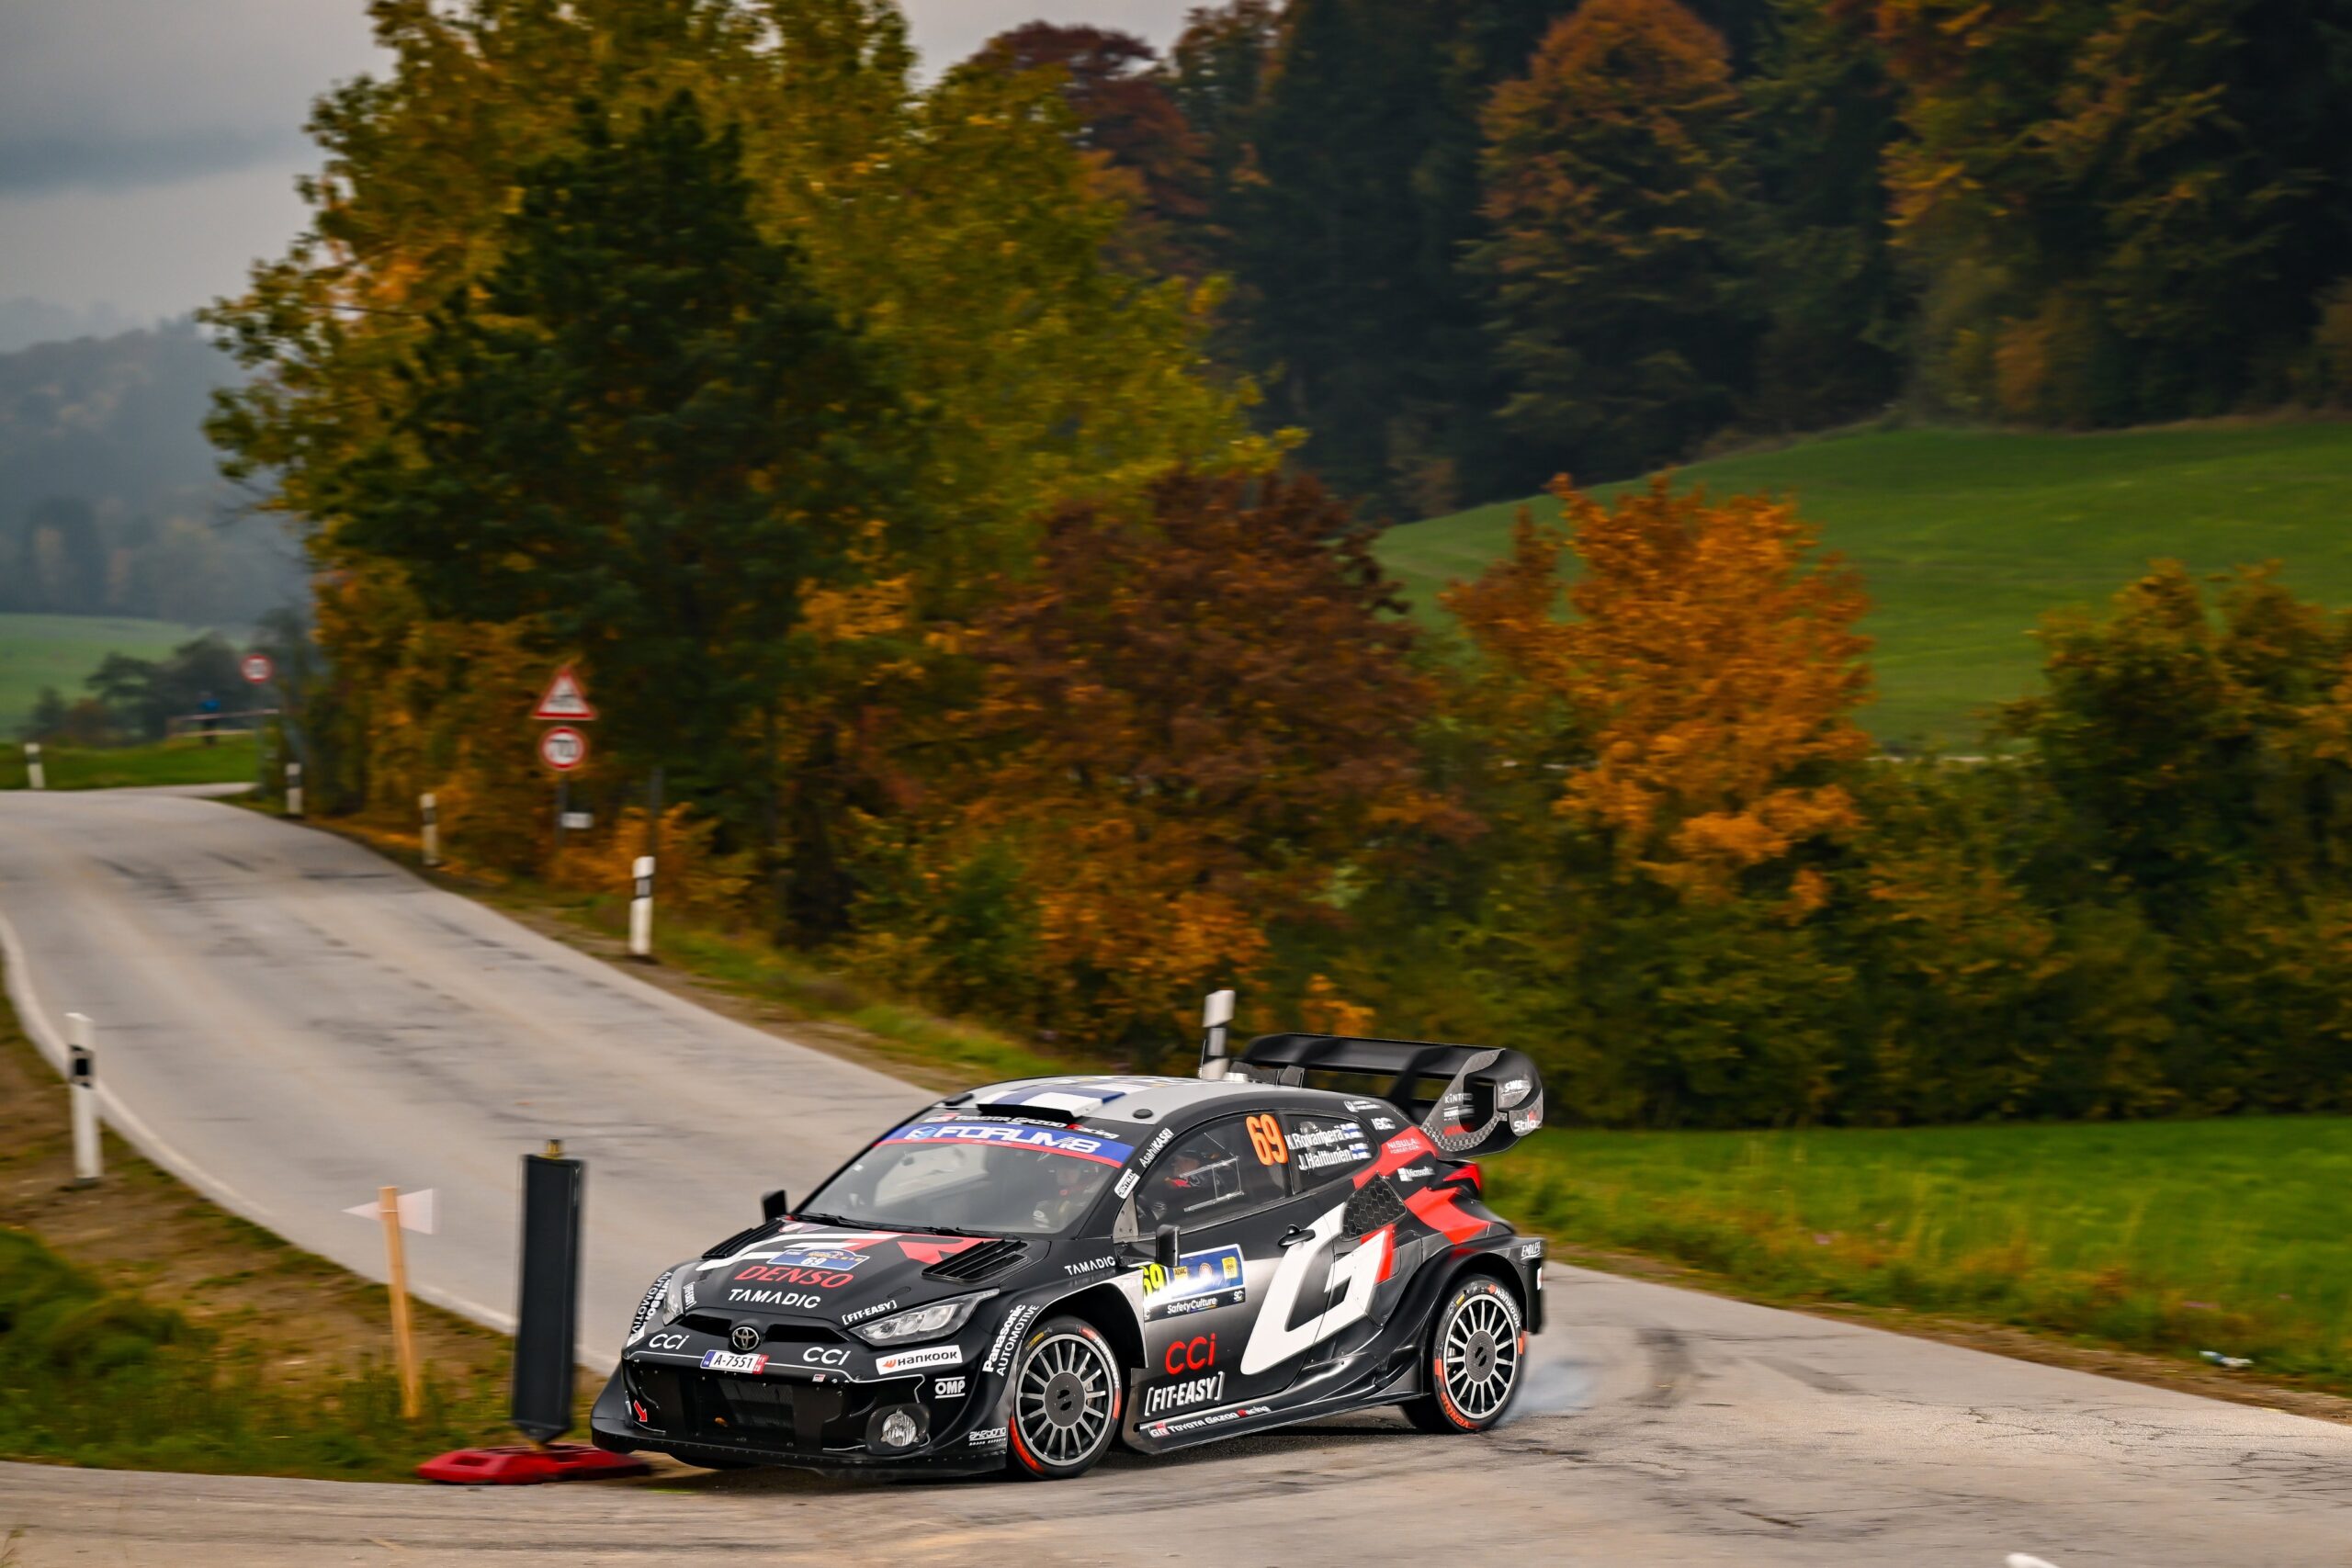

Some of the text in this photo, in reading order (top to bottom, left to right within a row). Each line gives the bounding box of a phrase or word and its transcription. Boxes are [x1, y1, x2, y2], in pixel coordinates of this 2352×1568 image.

[1246, 1113, 1289, 1166] 69
[1064, 1256, 1116, 1276] TAMADIC
[734, 1266, 854, 1289] DENSO
[728, 1289, 821, 1309] TAMADIC
[982, 1304, 1026, 1372] Panasonic
[996, 1304, 1039, 1377] AUTOMOTIVE
[713, 1354, 753, 1369] A-7551
[934, 1381, 966, 1395] OMP
